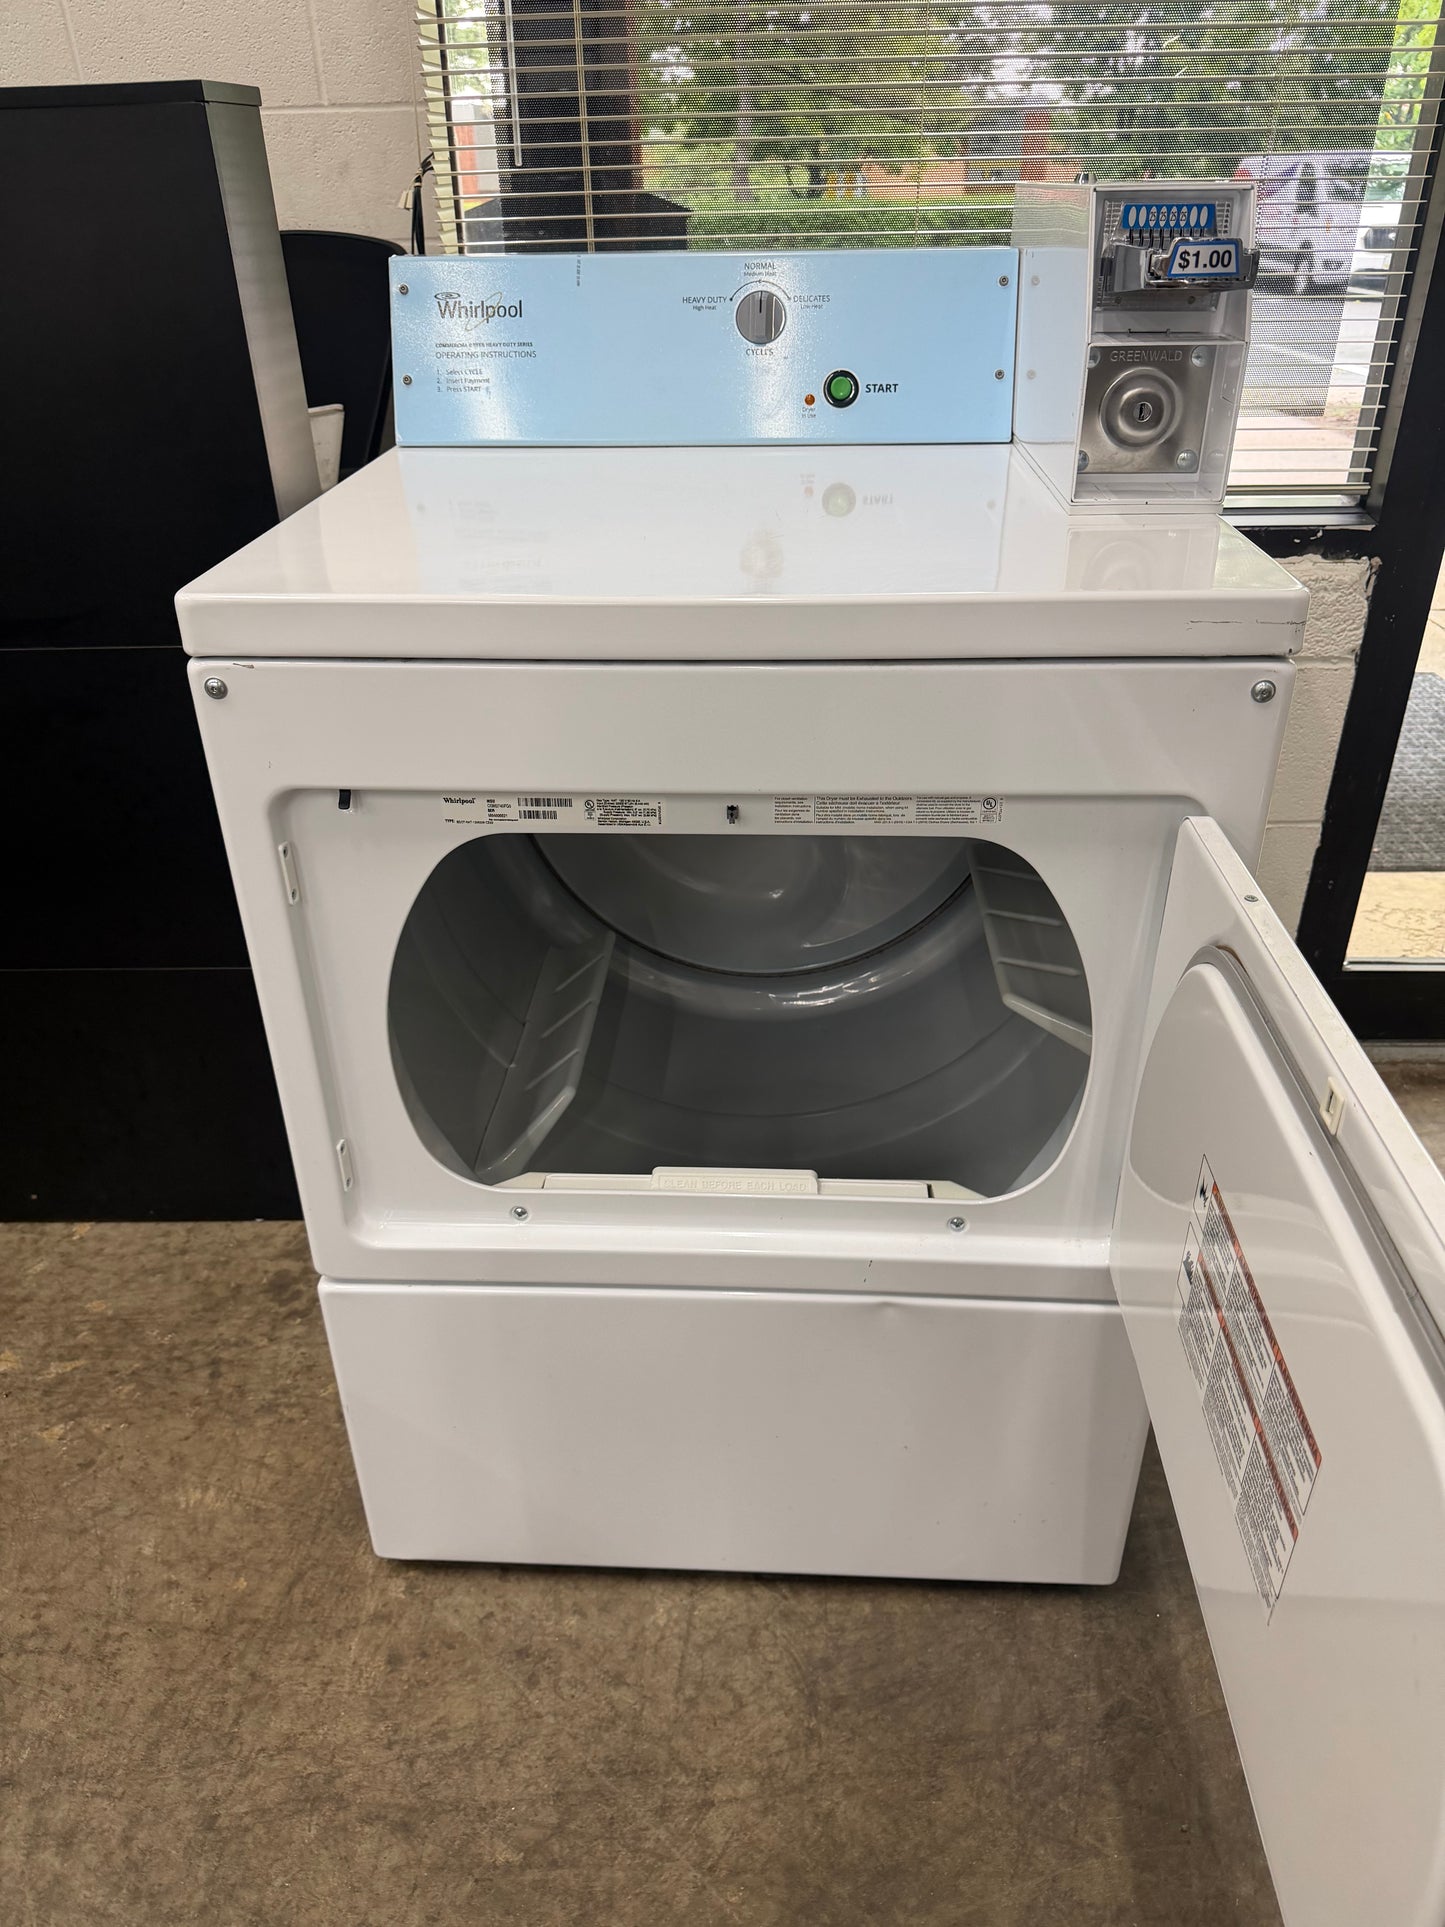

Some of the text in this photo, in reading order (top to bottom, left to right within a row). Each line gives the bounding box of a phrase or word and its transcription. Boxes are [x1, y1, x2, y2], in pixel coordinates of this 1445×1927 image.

[1149, 211, 1187, 222] 25 25 25 25
[1178, 249, 1232, 271] $1.00
[744, 262, 777, 270] NORMAL
[682, 296, 706, 304] HEAVY
[793, 295, 831, 303] DELICATES
[437, 299, 523, 324] Whirlpool
[435, 350, 537, 360] OPERATING INSTRUCTIONS
[745, 348, 774, 356] CYCLES
[1110, 350, 1183, 362] GREENWALD
[865, 383, 899, 394] START
[443, 797, 476, 806] Whirlpool
[663, 1178, 809, 1192] CLEAN BEFORE EACH LOAD
